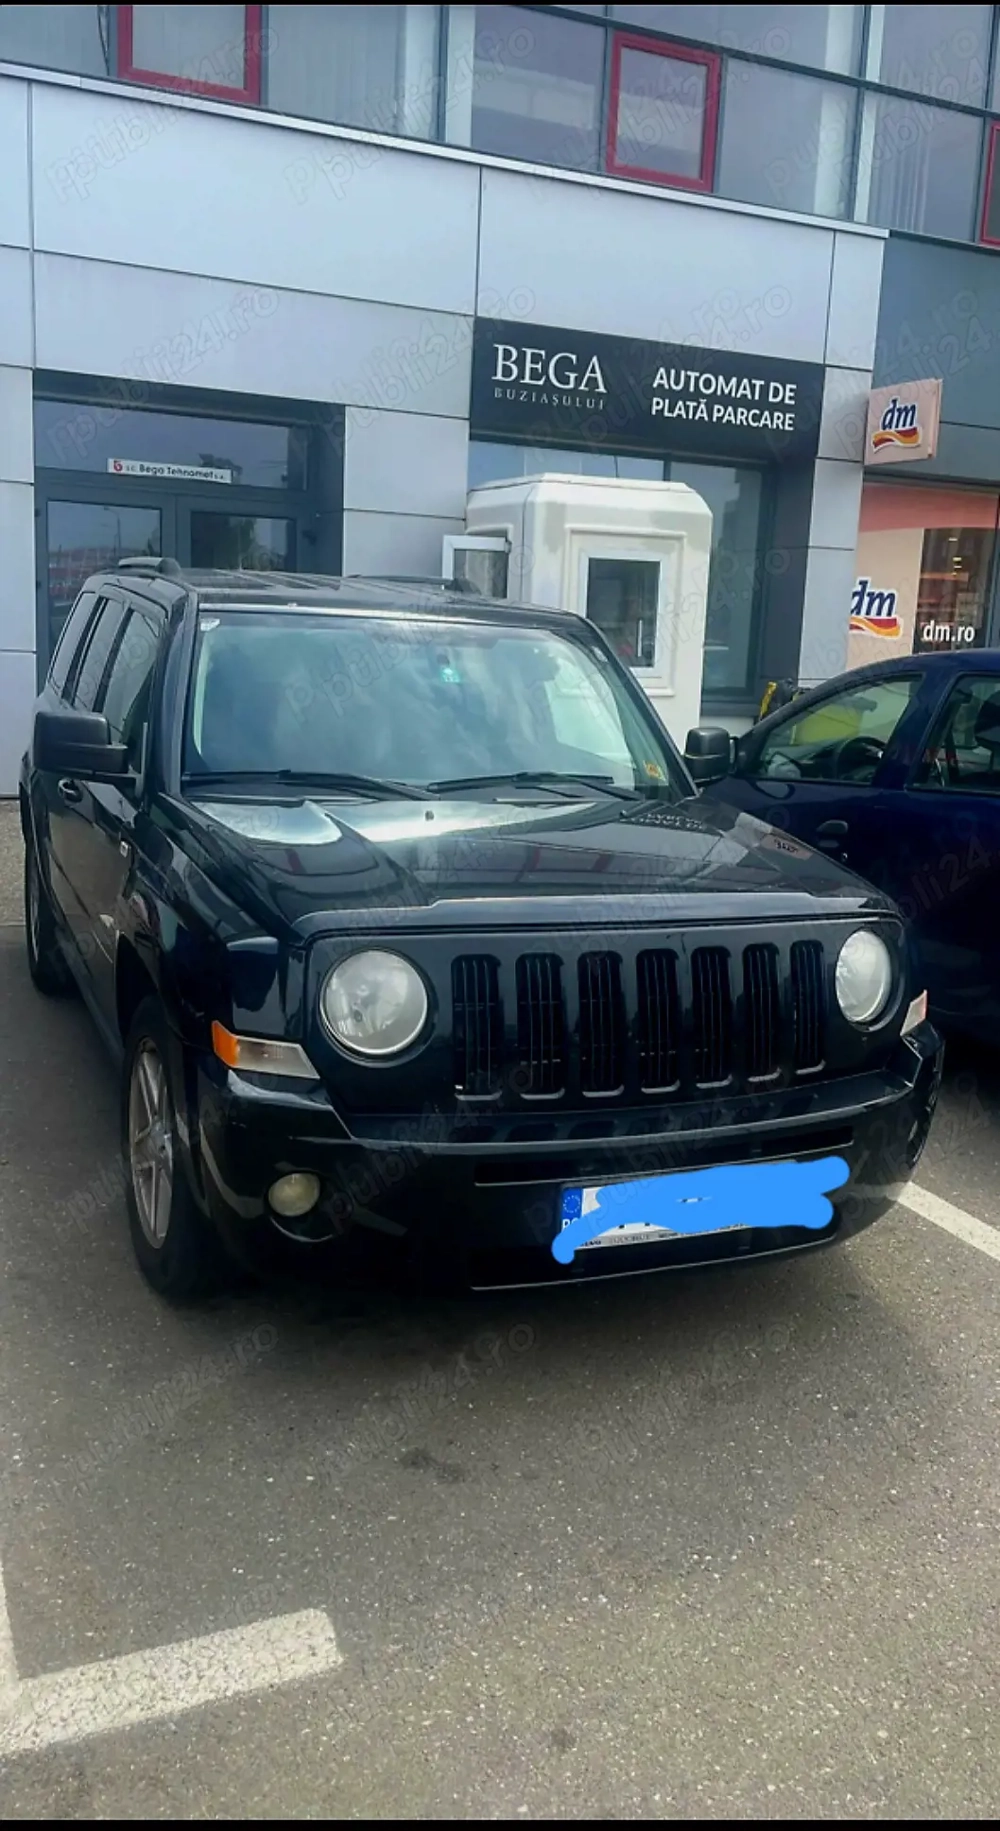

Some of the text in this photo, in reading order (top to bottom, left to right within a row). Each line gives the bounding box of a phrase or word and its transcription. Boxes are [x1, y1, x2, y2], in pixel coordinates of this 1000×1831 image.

[491, 343, 608, 393] BEGA
[652, 366, 797, 405] AUTOMAT DE
[651, 397, 796, 431] PLATĂ PARCARE
[881, 398, 917, 431] dm
[850, 580, 896, 617] dm
[922, 619, 976, 643] dm.ro
